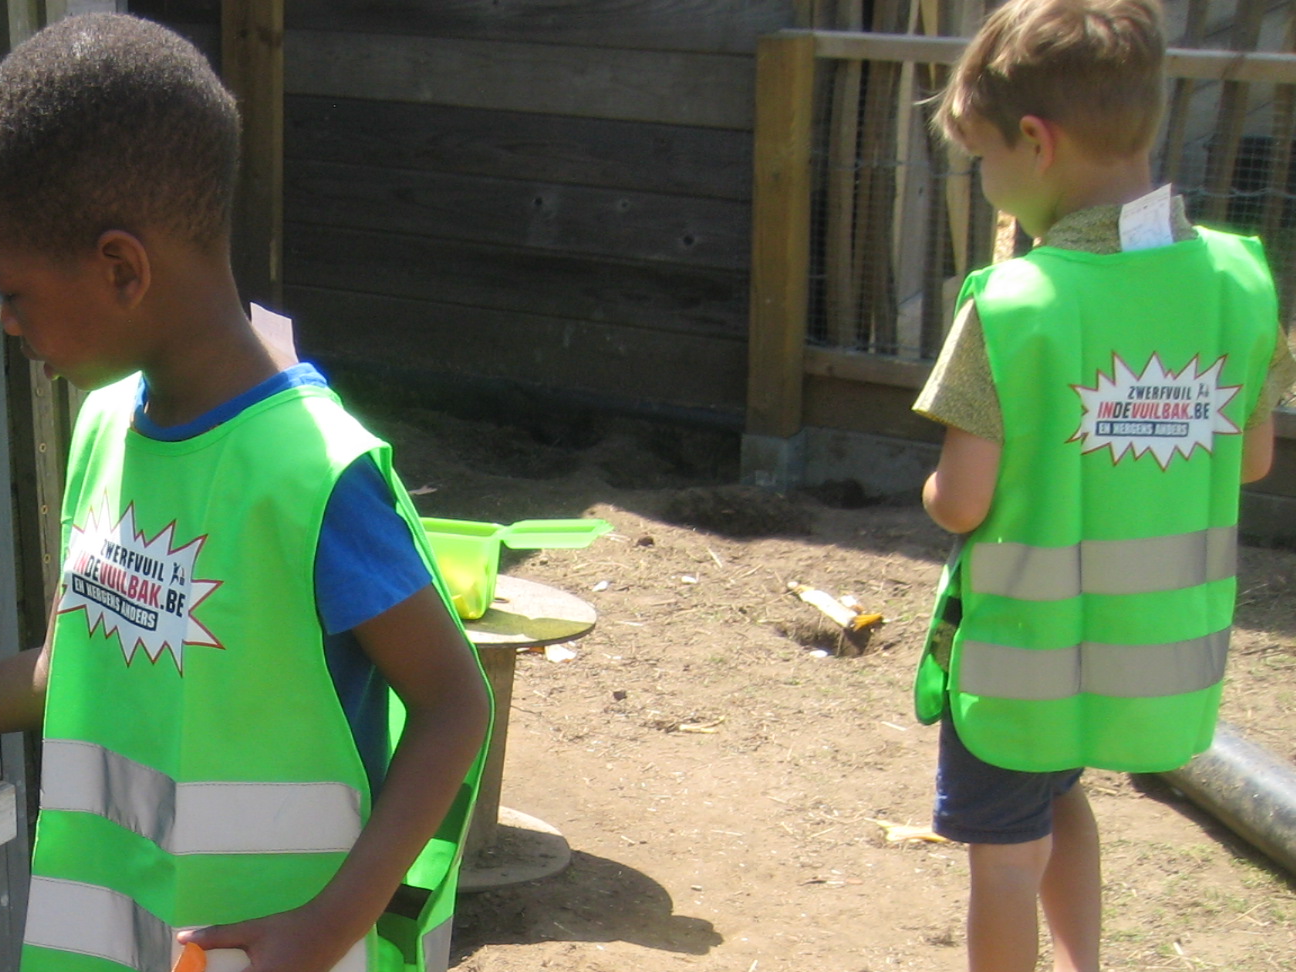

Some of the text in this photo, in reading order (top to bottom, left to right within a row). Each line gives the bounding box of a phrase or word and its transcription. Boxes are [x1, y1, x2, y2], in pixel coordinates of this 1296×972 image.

[1128, 386, 1191, 400] ZWERFVUIL
[1097, 402, 1210, 419] INDEVUILBAK.BE
[100, 539, 164, 582] ZWERFVUIL
[74, 551, 186, 618] INDEVUILBAK.BE
